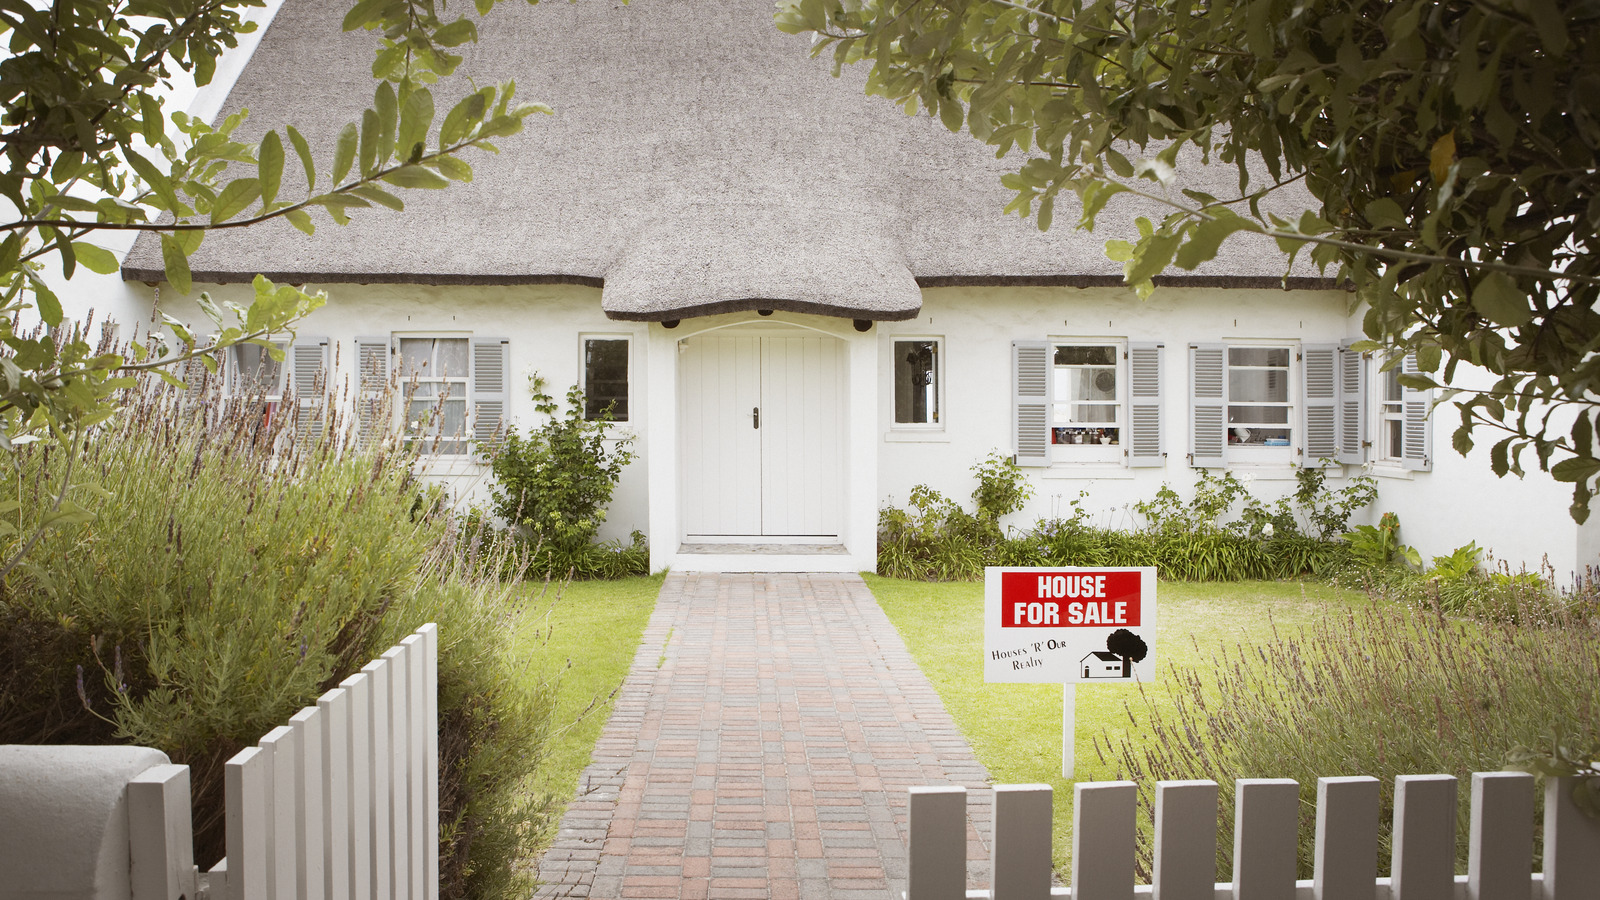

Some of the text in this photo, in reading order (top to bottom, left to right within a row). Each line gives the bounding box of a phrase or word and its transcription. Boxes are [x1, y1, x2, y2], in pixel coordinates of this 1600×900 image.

[1037, 575, 1106, 598] HOUSE
[1014, 601, 1127, 625] FOR SALE
